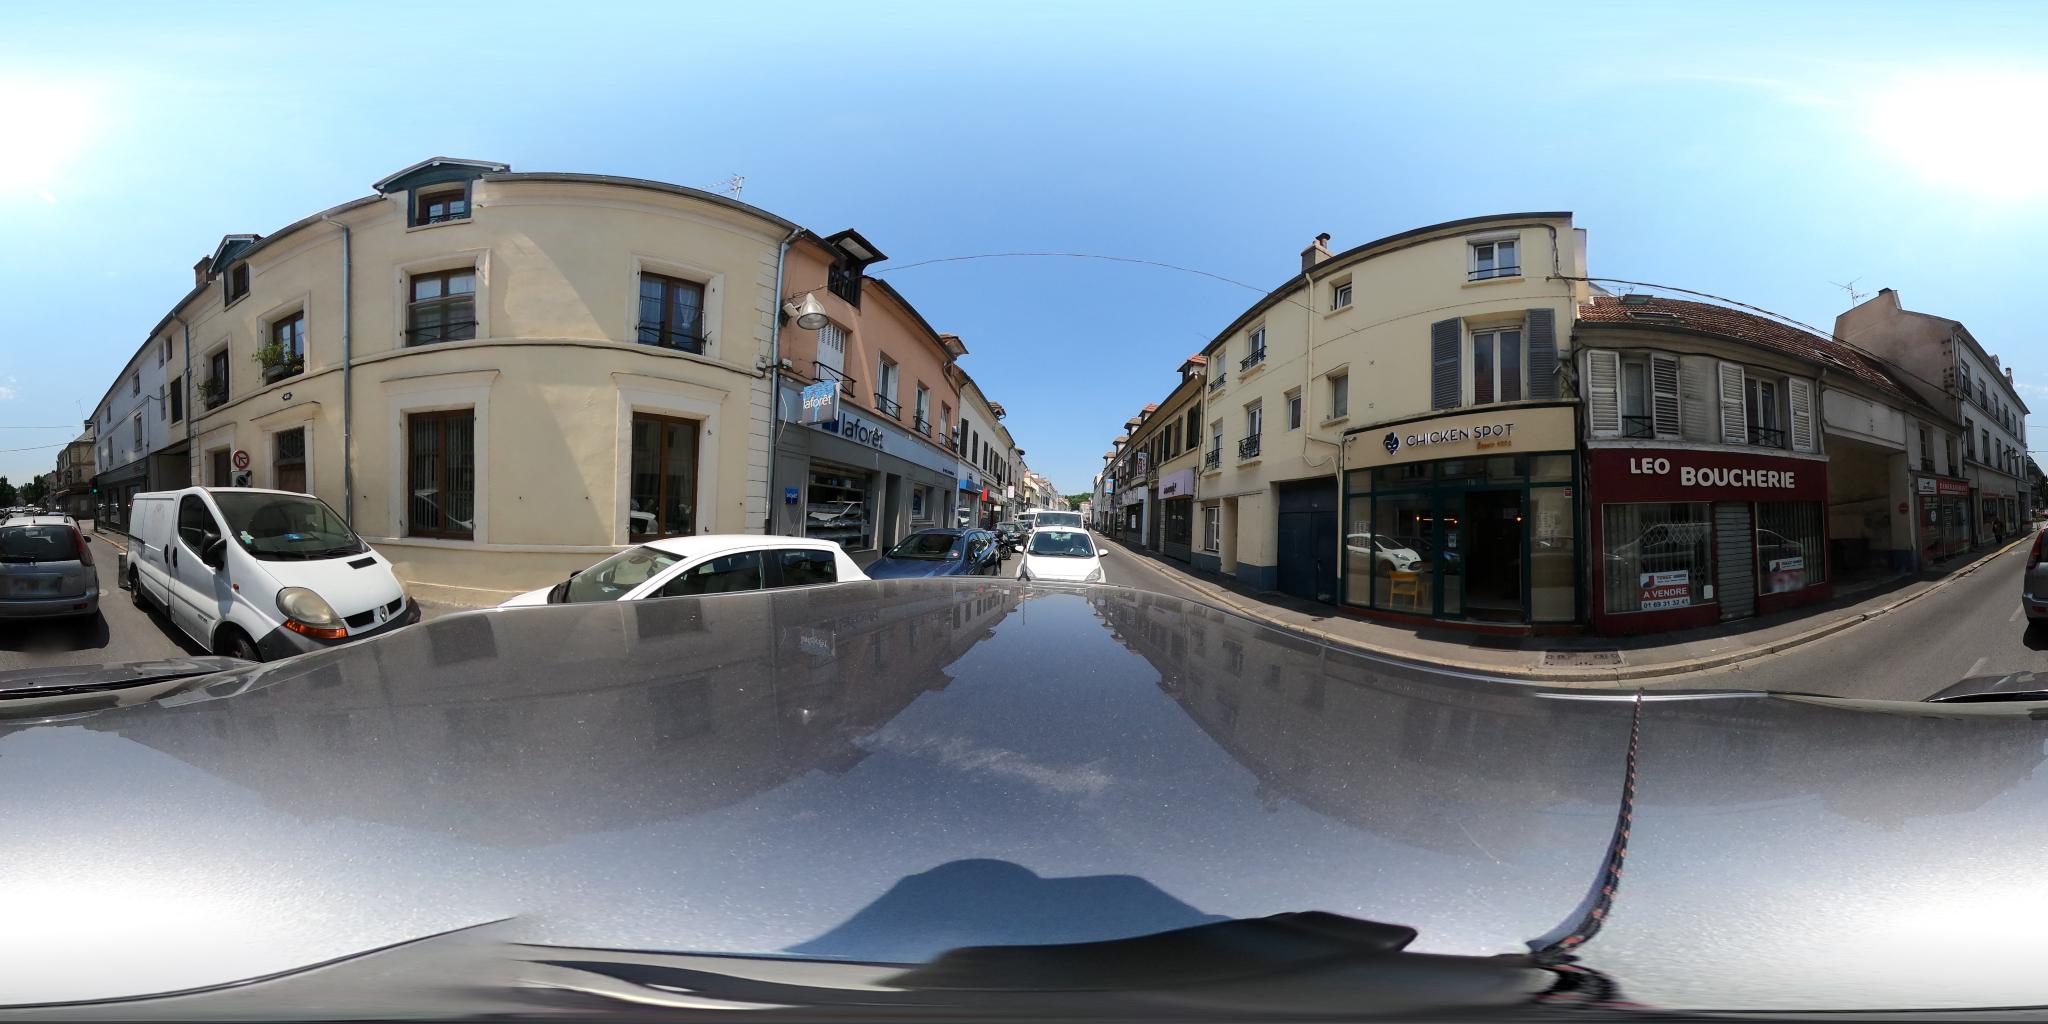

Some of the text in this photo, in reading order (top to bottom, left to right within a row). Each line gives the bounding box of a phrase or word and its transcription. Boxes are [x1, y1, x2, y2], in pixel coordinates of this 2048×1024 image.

[803, 394, 832, 409] laforêt
[841, 413, 884, 449] laforêt
[1406, 427, 1470, 447] CHICKEN
[1474, 423, 1514, 439] SPOT
[1630, 458, 1670, 475] LEO
[1680, 466, 1796, 489] BOUCHERIE
[1652, 588, 1687, 598] VENDRE
